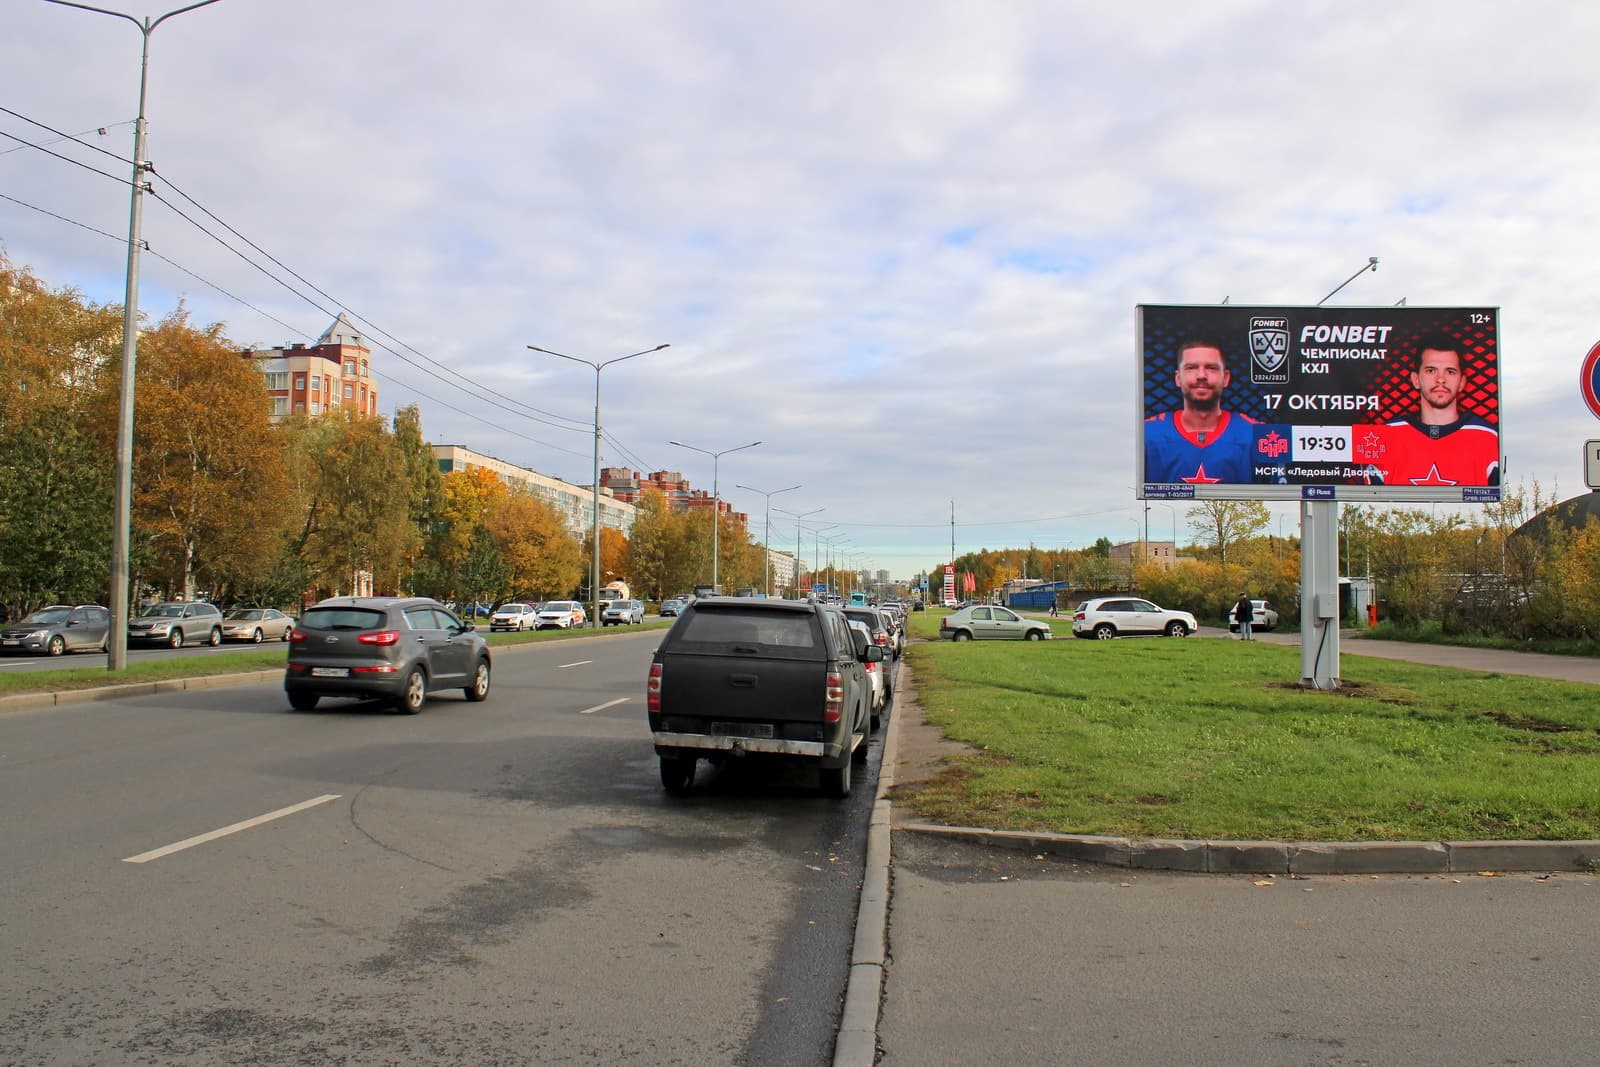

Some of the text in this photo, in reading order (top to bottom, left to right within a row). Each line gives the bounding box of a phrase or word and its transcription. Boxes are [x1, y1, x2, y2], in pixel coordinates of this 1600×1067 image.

[1470, 313, 1491, 324] 12+
[1301, 326, 1392, 343] FONBET
[1301, 348, 1387, 360] ЧЕМПИОНАТ
[1301, 363, 1329, 374] КХЛ
[1263, 395, 1379, 411] 17 ОКТЯБРЯ
[1299, 437, 1346, 451] 19:30
[1255, 467, 1285, 476] МСРК
[1287, 466, 1340, 478] «Ледовый
